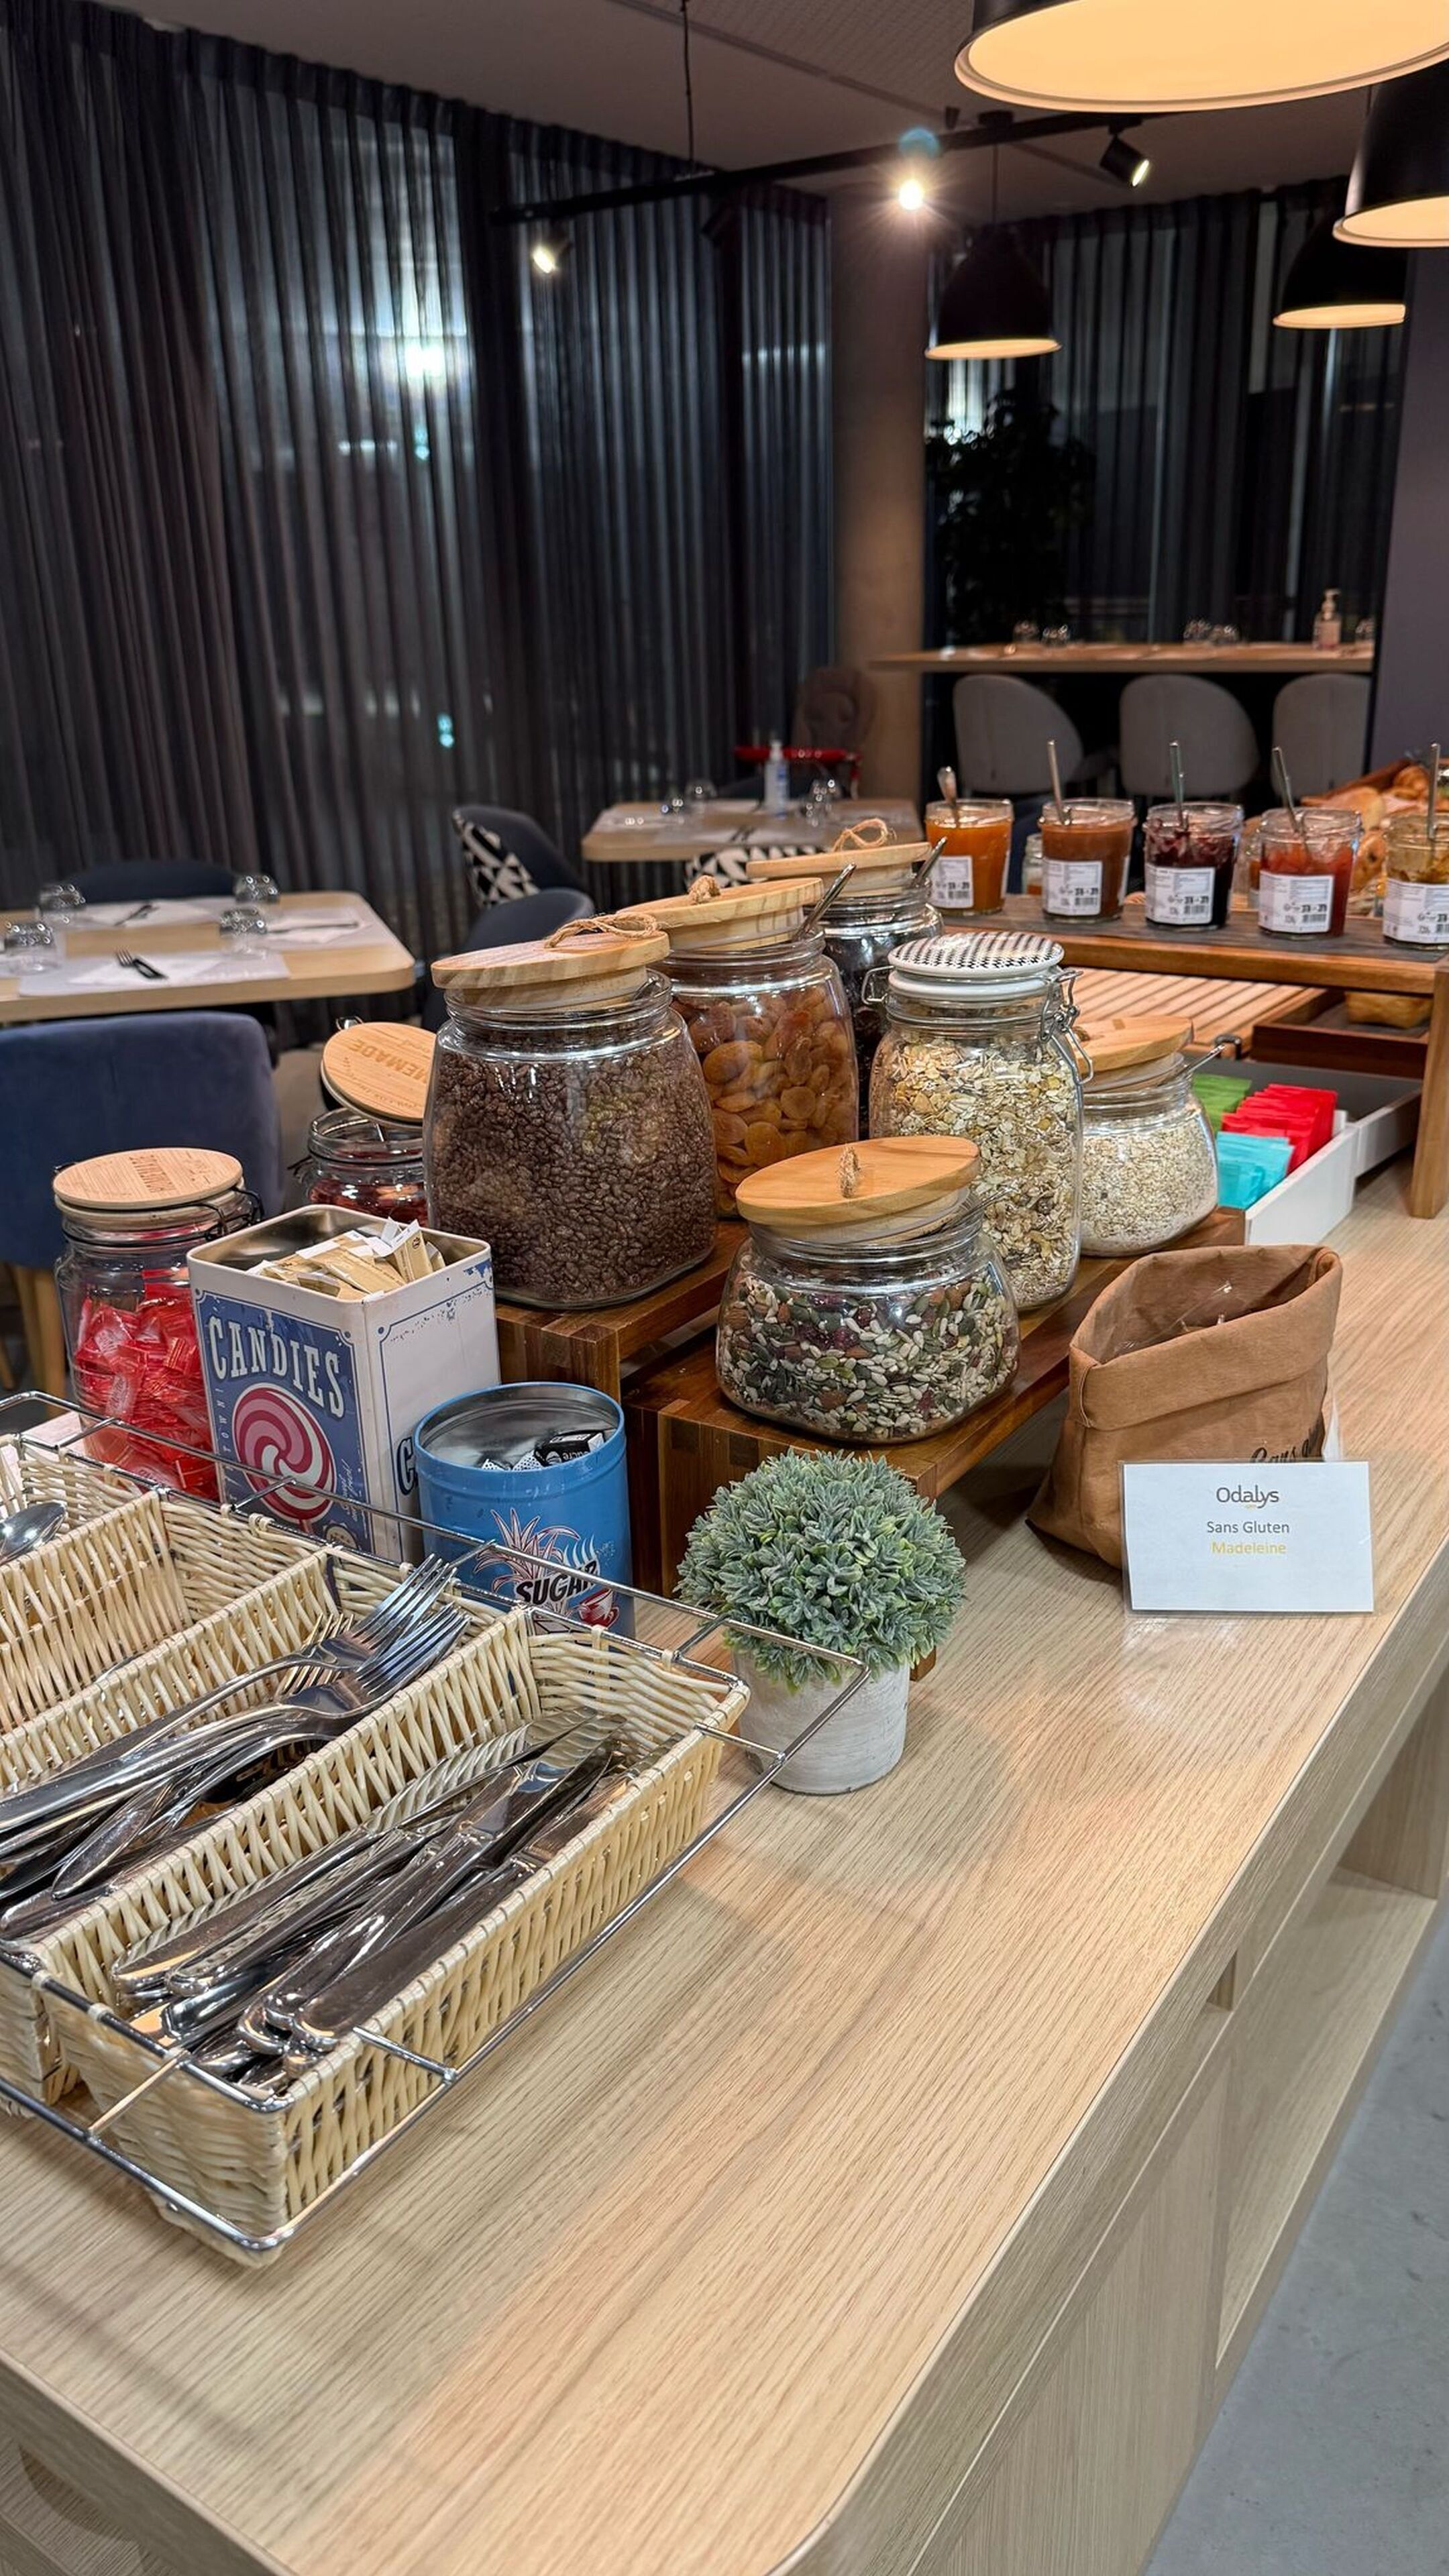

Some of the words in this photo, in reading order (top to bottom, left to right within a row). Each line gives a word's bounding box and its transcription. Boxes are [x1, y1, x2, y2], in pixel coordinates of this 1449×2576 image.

[209, 1316, 344, 1417] CANDIES
[1216, 1485, 1279, 1509] Odalys
[1208, 1521, 1238, 1533] Sans
[1243, 1521, 1289, 1533] Gluten
[1212, 1542, 1287, 1554] Madeleine
[516, 1560, 596, 1605] SUGAR
